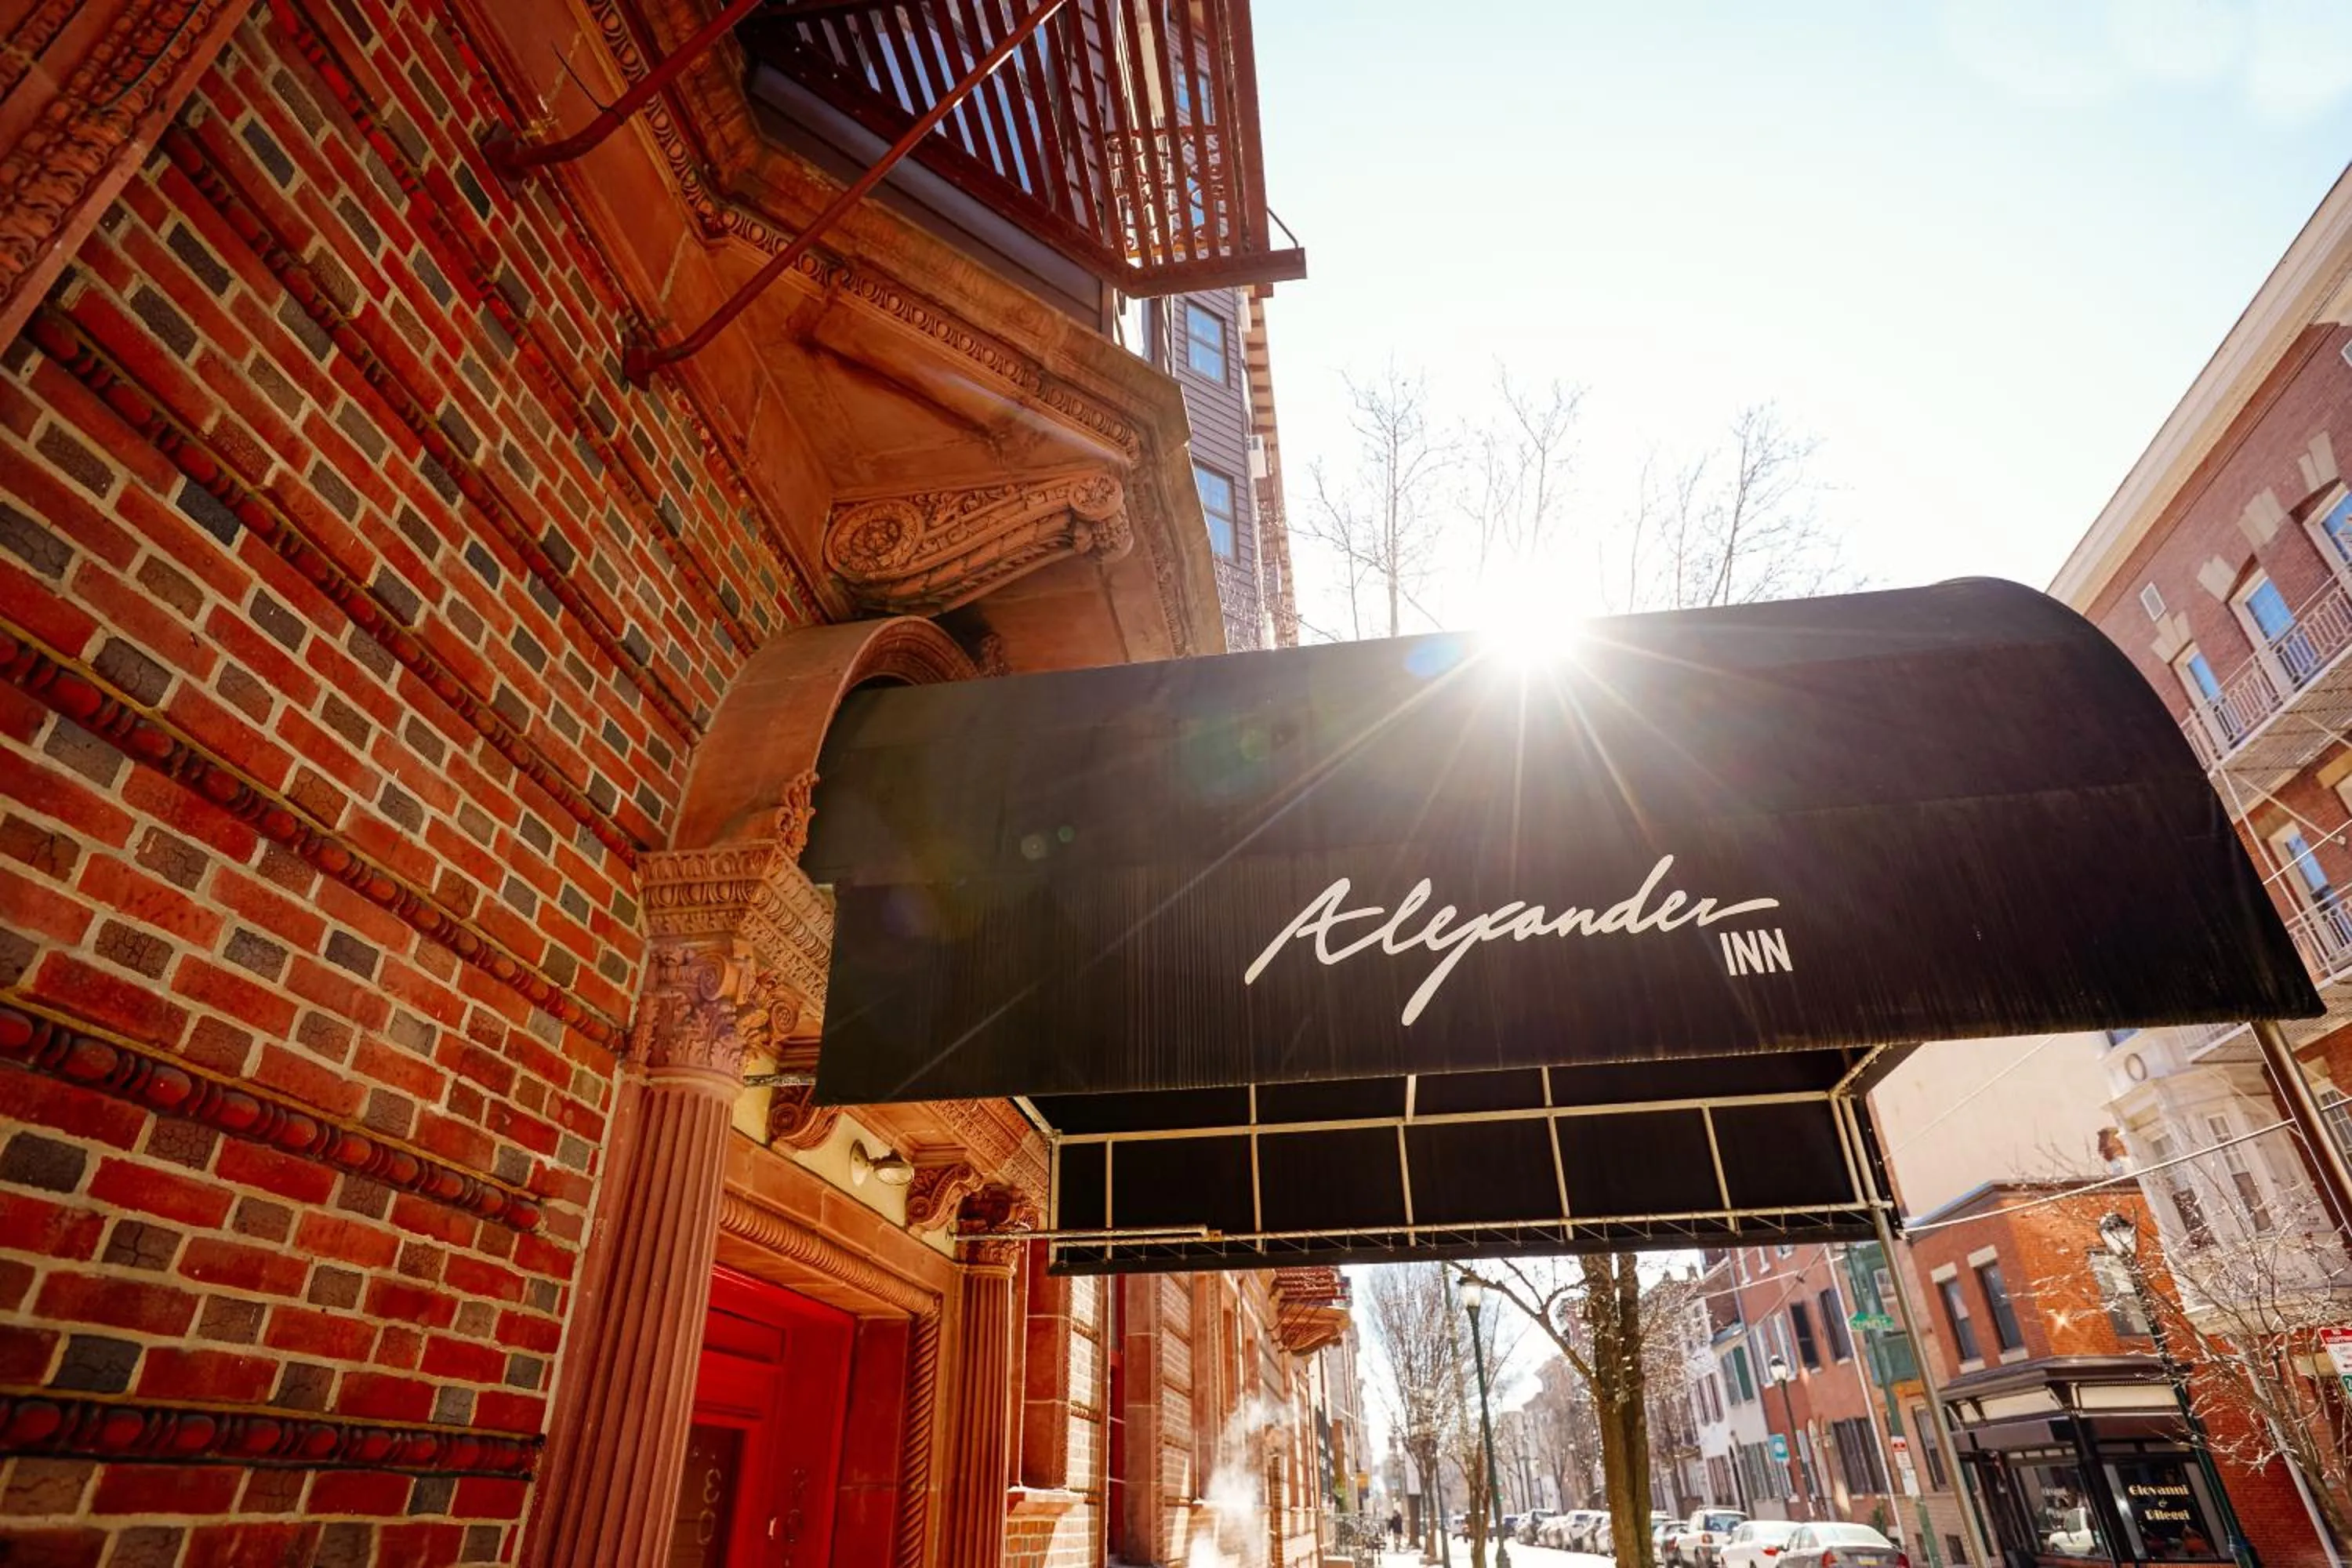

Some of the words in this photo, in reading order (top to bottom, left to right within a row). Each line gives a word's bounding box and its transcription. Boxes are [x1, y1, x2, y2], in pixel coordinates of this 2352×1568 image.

[1244, 854, 1780, 1026] Alexander
[1719, 927, 1793, 976] INN
[2129, 1484, 2189, 1496] Giovanni
